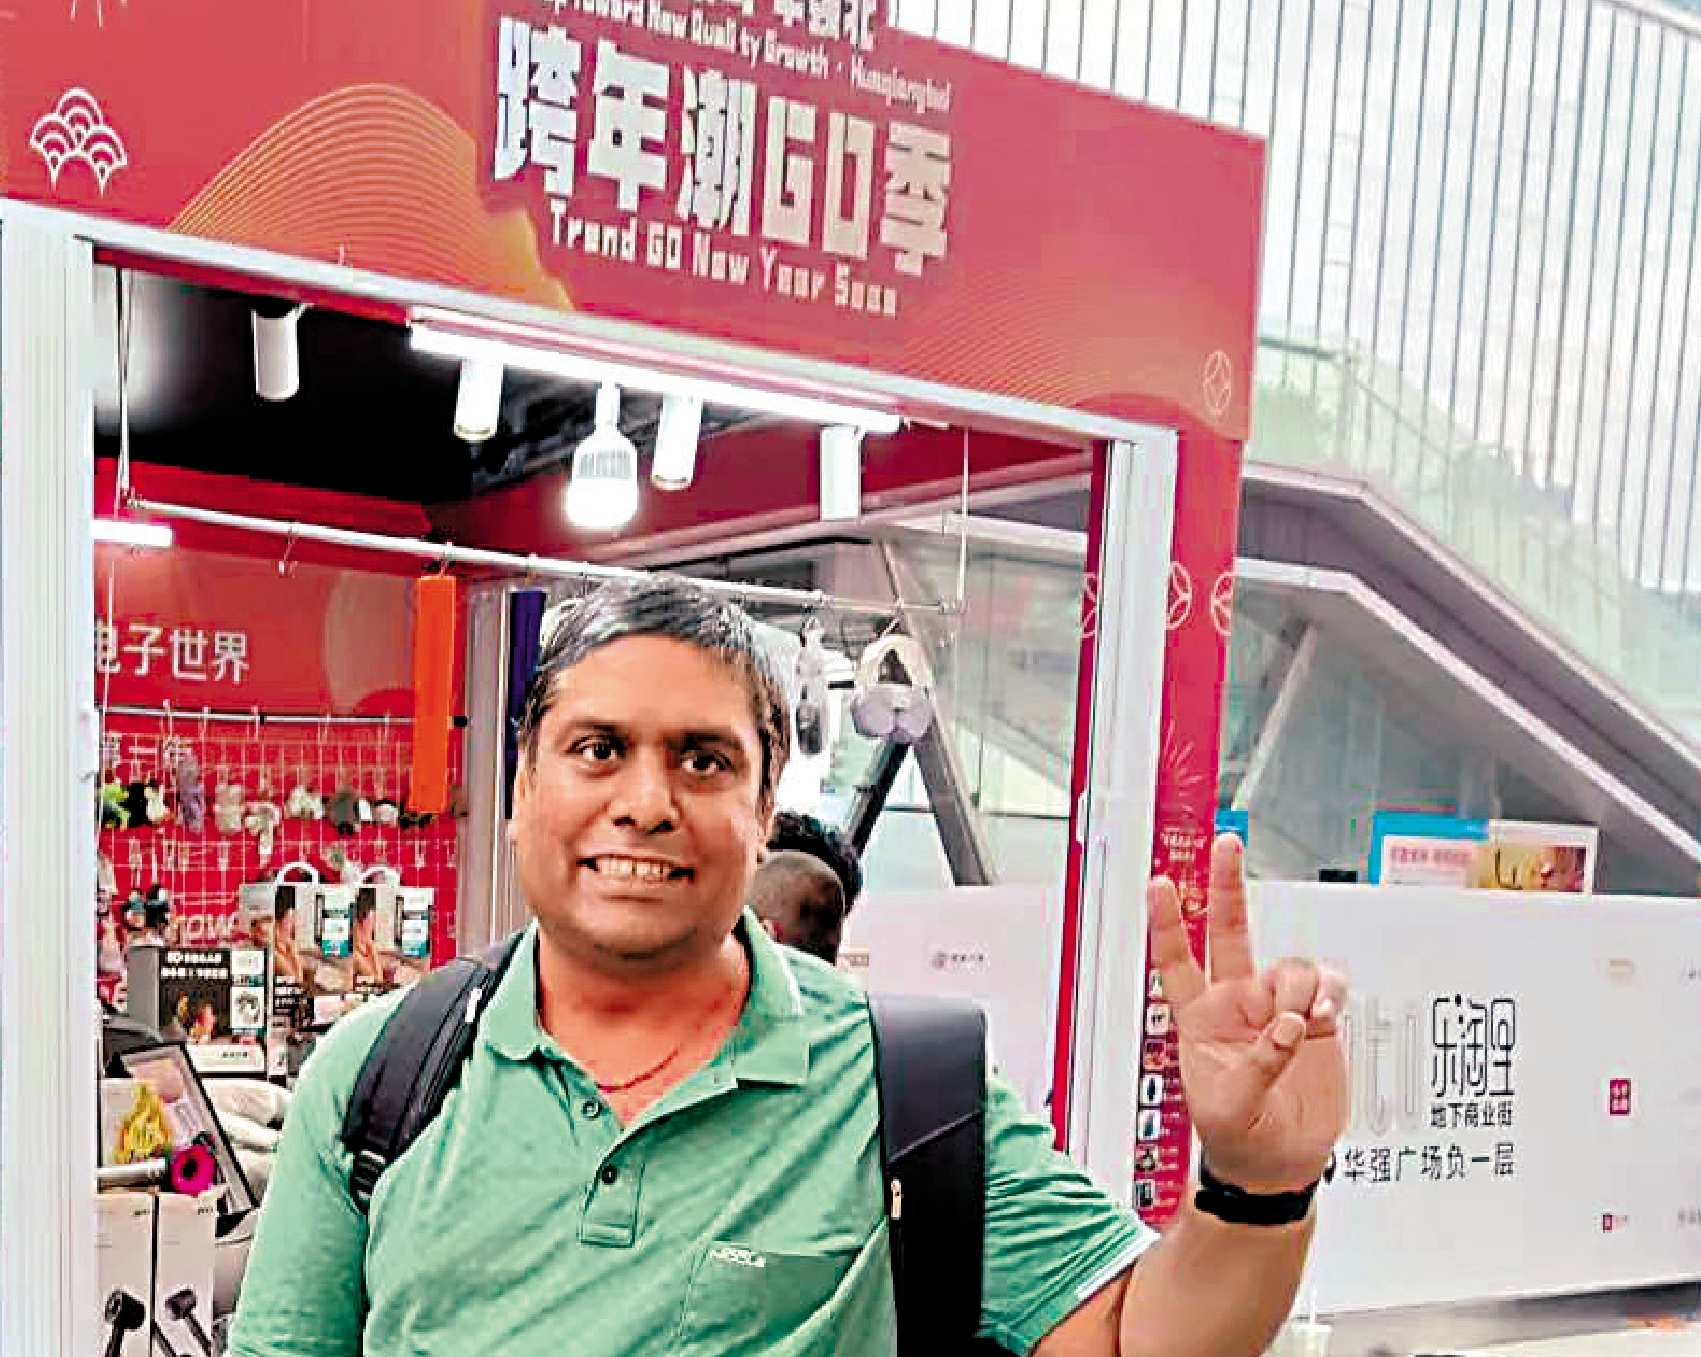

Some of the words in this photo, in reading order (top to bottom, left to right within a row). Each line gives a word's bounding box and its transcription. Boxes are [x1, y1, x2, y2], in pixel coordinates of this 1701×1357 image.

[646, 222, 683, 270] GO
[1344, 1142, 1514, 1182] 华强广场负一层
